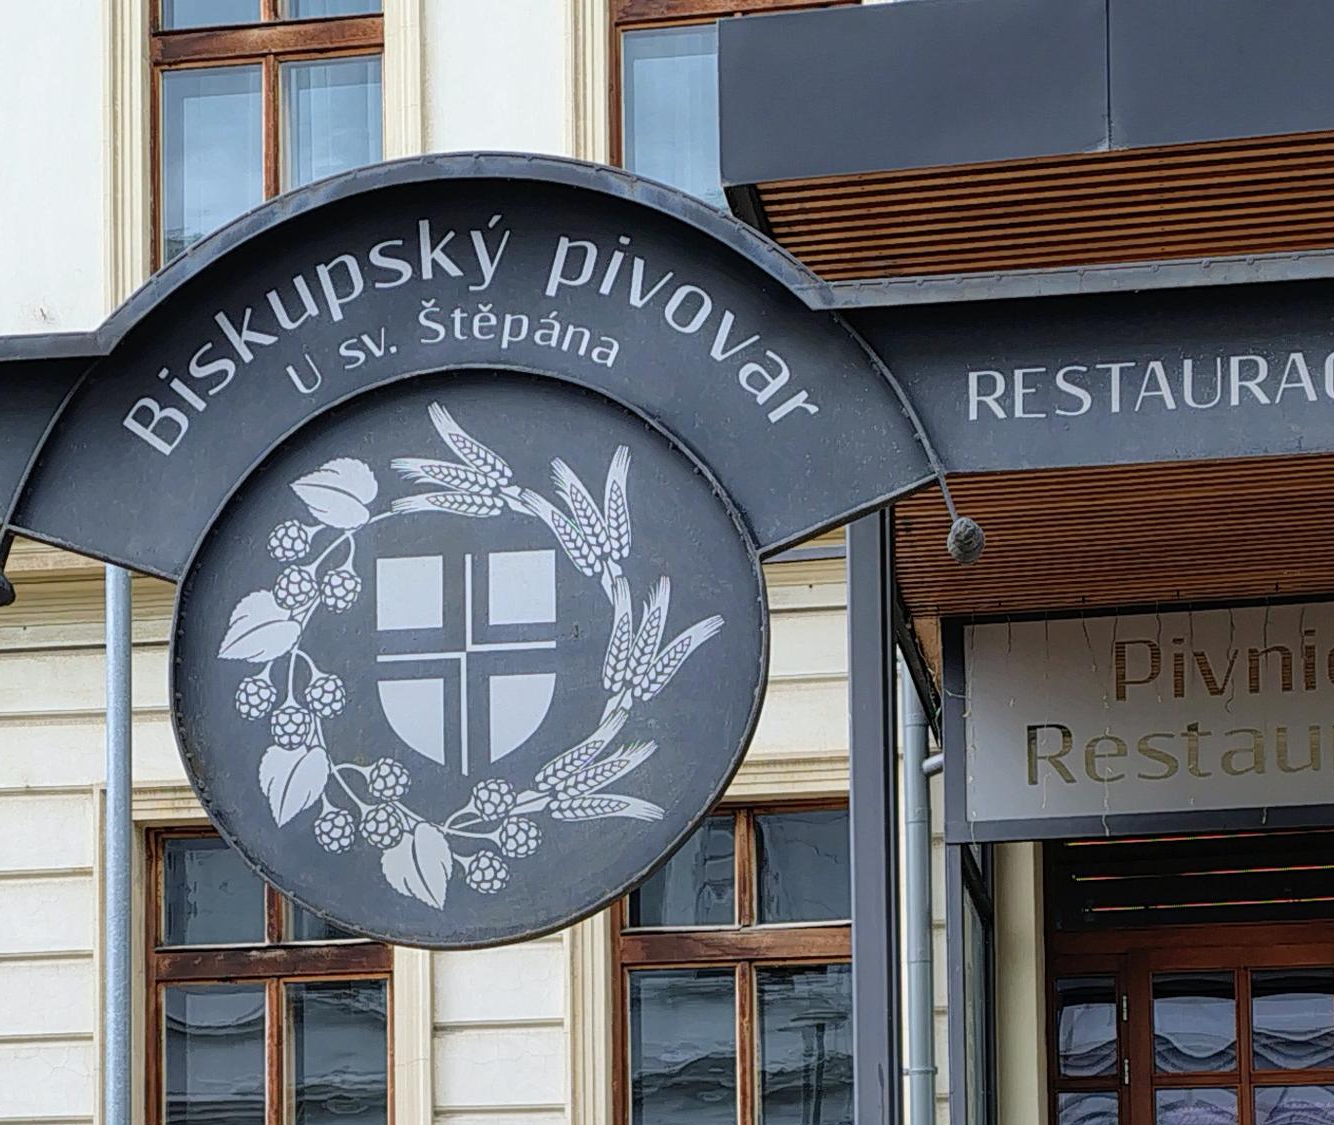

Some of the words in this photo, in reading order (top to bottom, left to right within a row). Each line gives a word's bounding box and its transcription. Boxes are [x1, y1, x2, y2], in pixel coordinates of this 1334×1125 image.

[122, 213, 511, 456] Biskupský
[544, 233, 819, 425] pivovar
[285, 352, 323, 395] U
[338, 325, 399, 370] sv.
[417, 298, 622, 369] Štěpána
